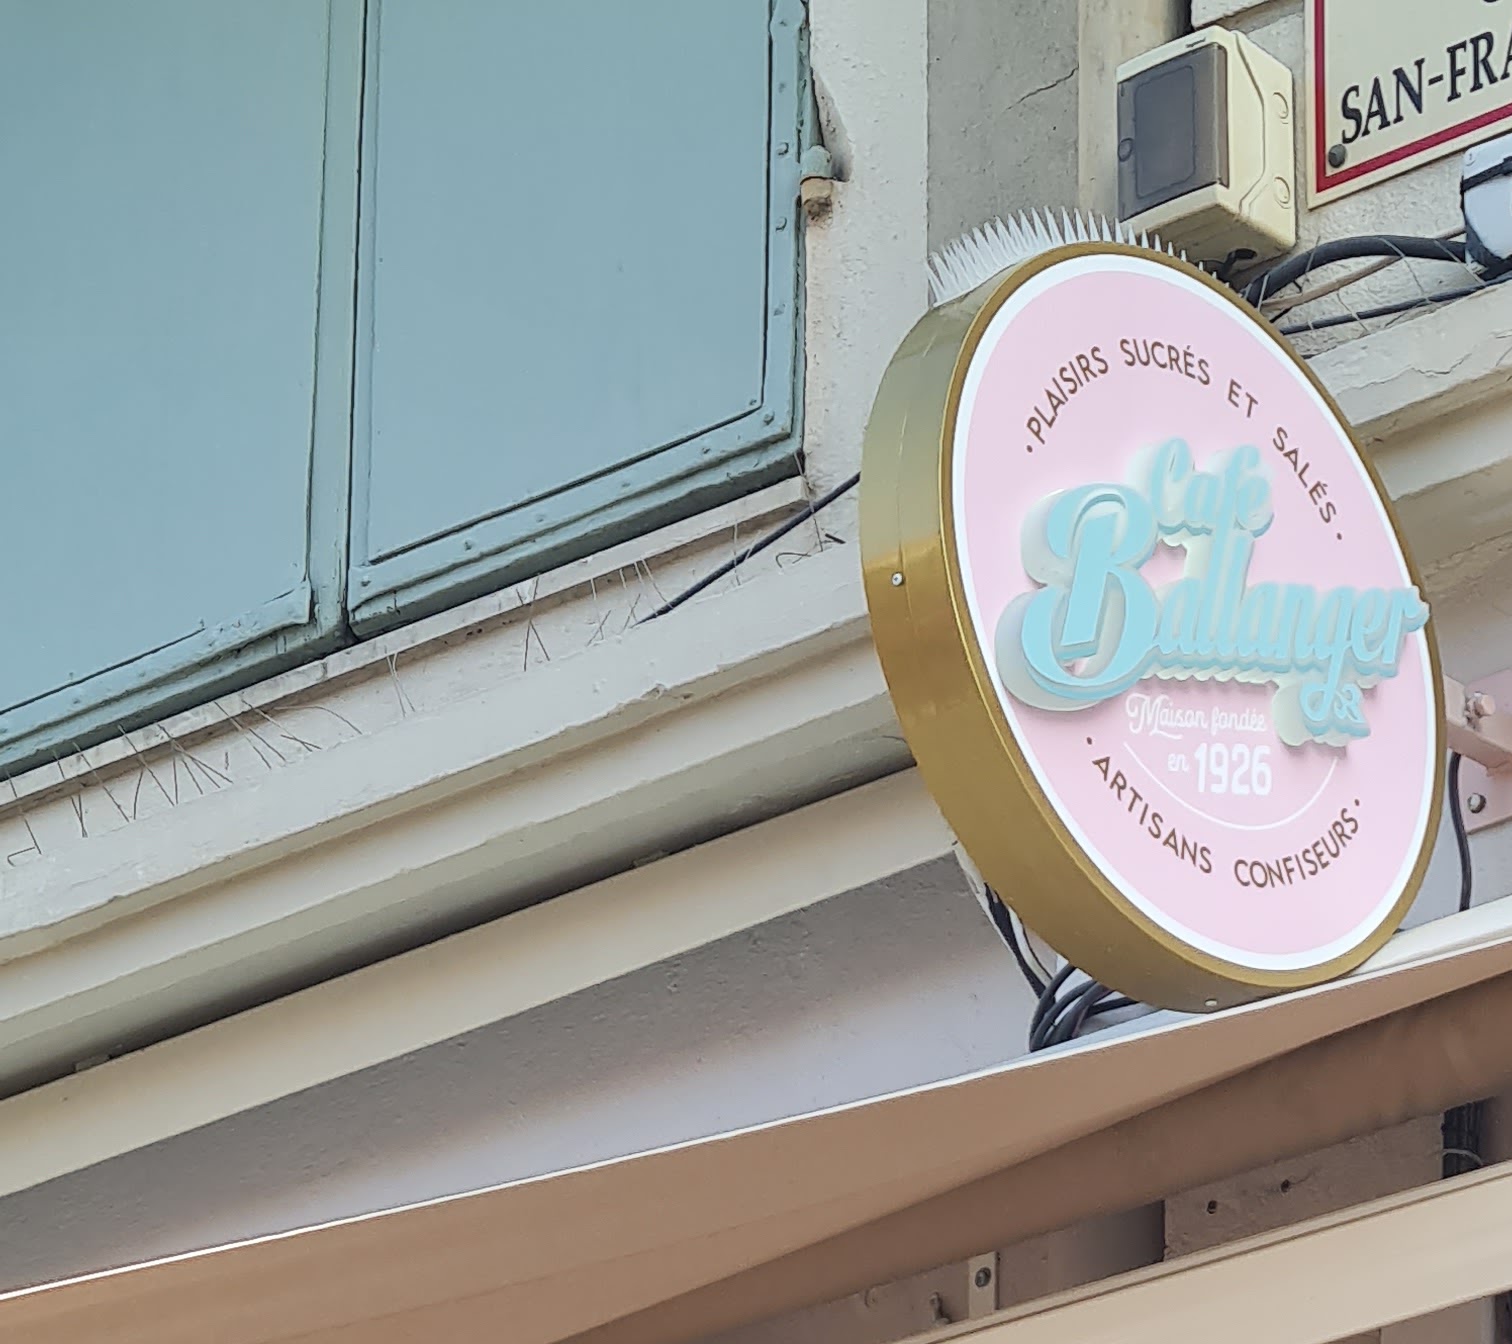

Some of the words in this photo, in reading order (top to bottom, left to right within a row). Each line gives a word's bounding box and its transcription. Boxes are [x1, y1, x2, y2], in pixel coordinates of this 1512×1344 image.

[1026, 346, 1110, 445] PLAISIRS
[1119, 338, 1211, 386] SUCRÉS
[1228, 378, 1259, 418] ET
[1272, 426, 1338, 524] SALÉS
[1018, 482, 1430, 738] Ballanger
[1125, 692, 1208, 740] Maison
[1210, 706, 1268, 736] fondée
[1167, 751, 1190, 772] en
[1194, 742, 1272, 796] 1926
[1091, 756, 1213, 874] ARTISANS
[1234, 807, 1360, 889] CONFISEURS
